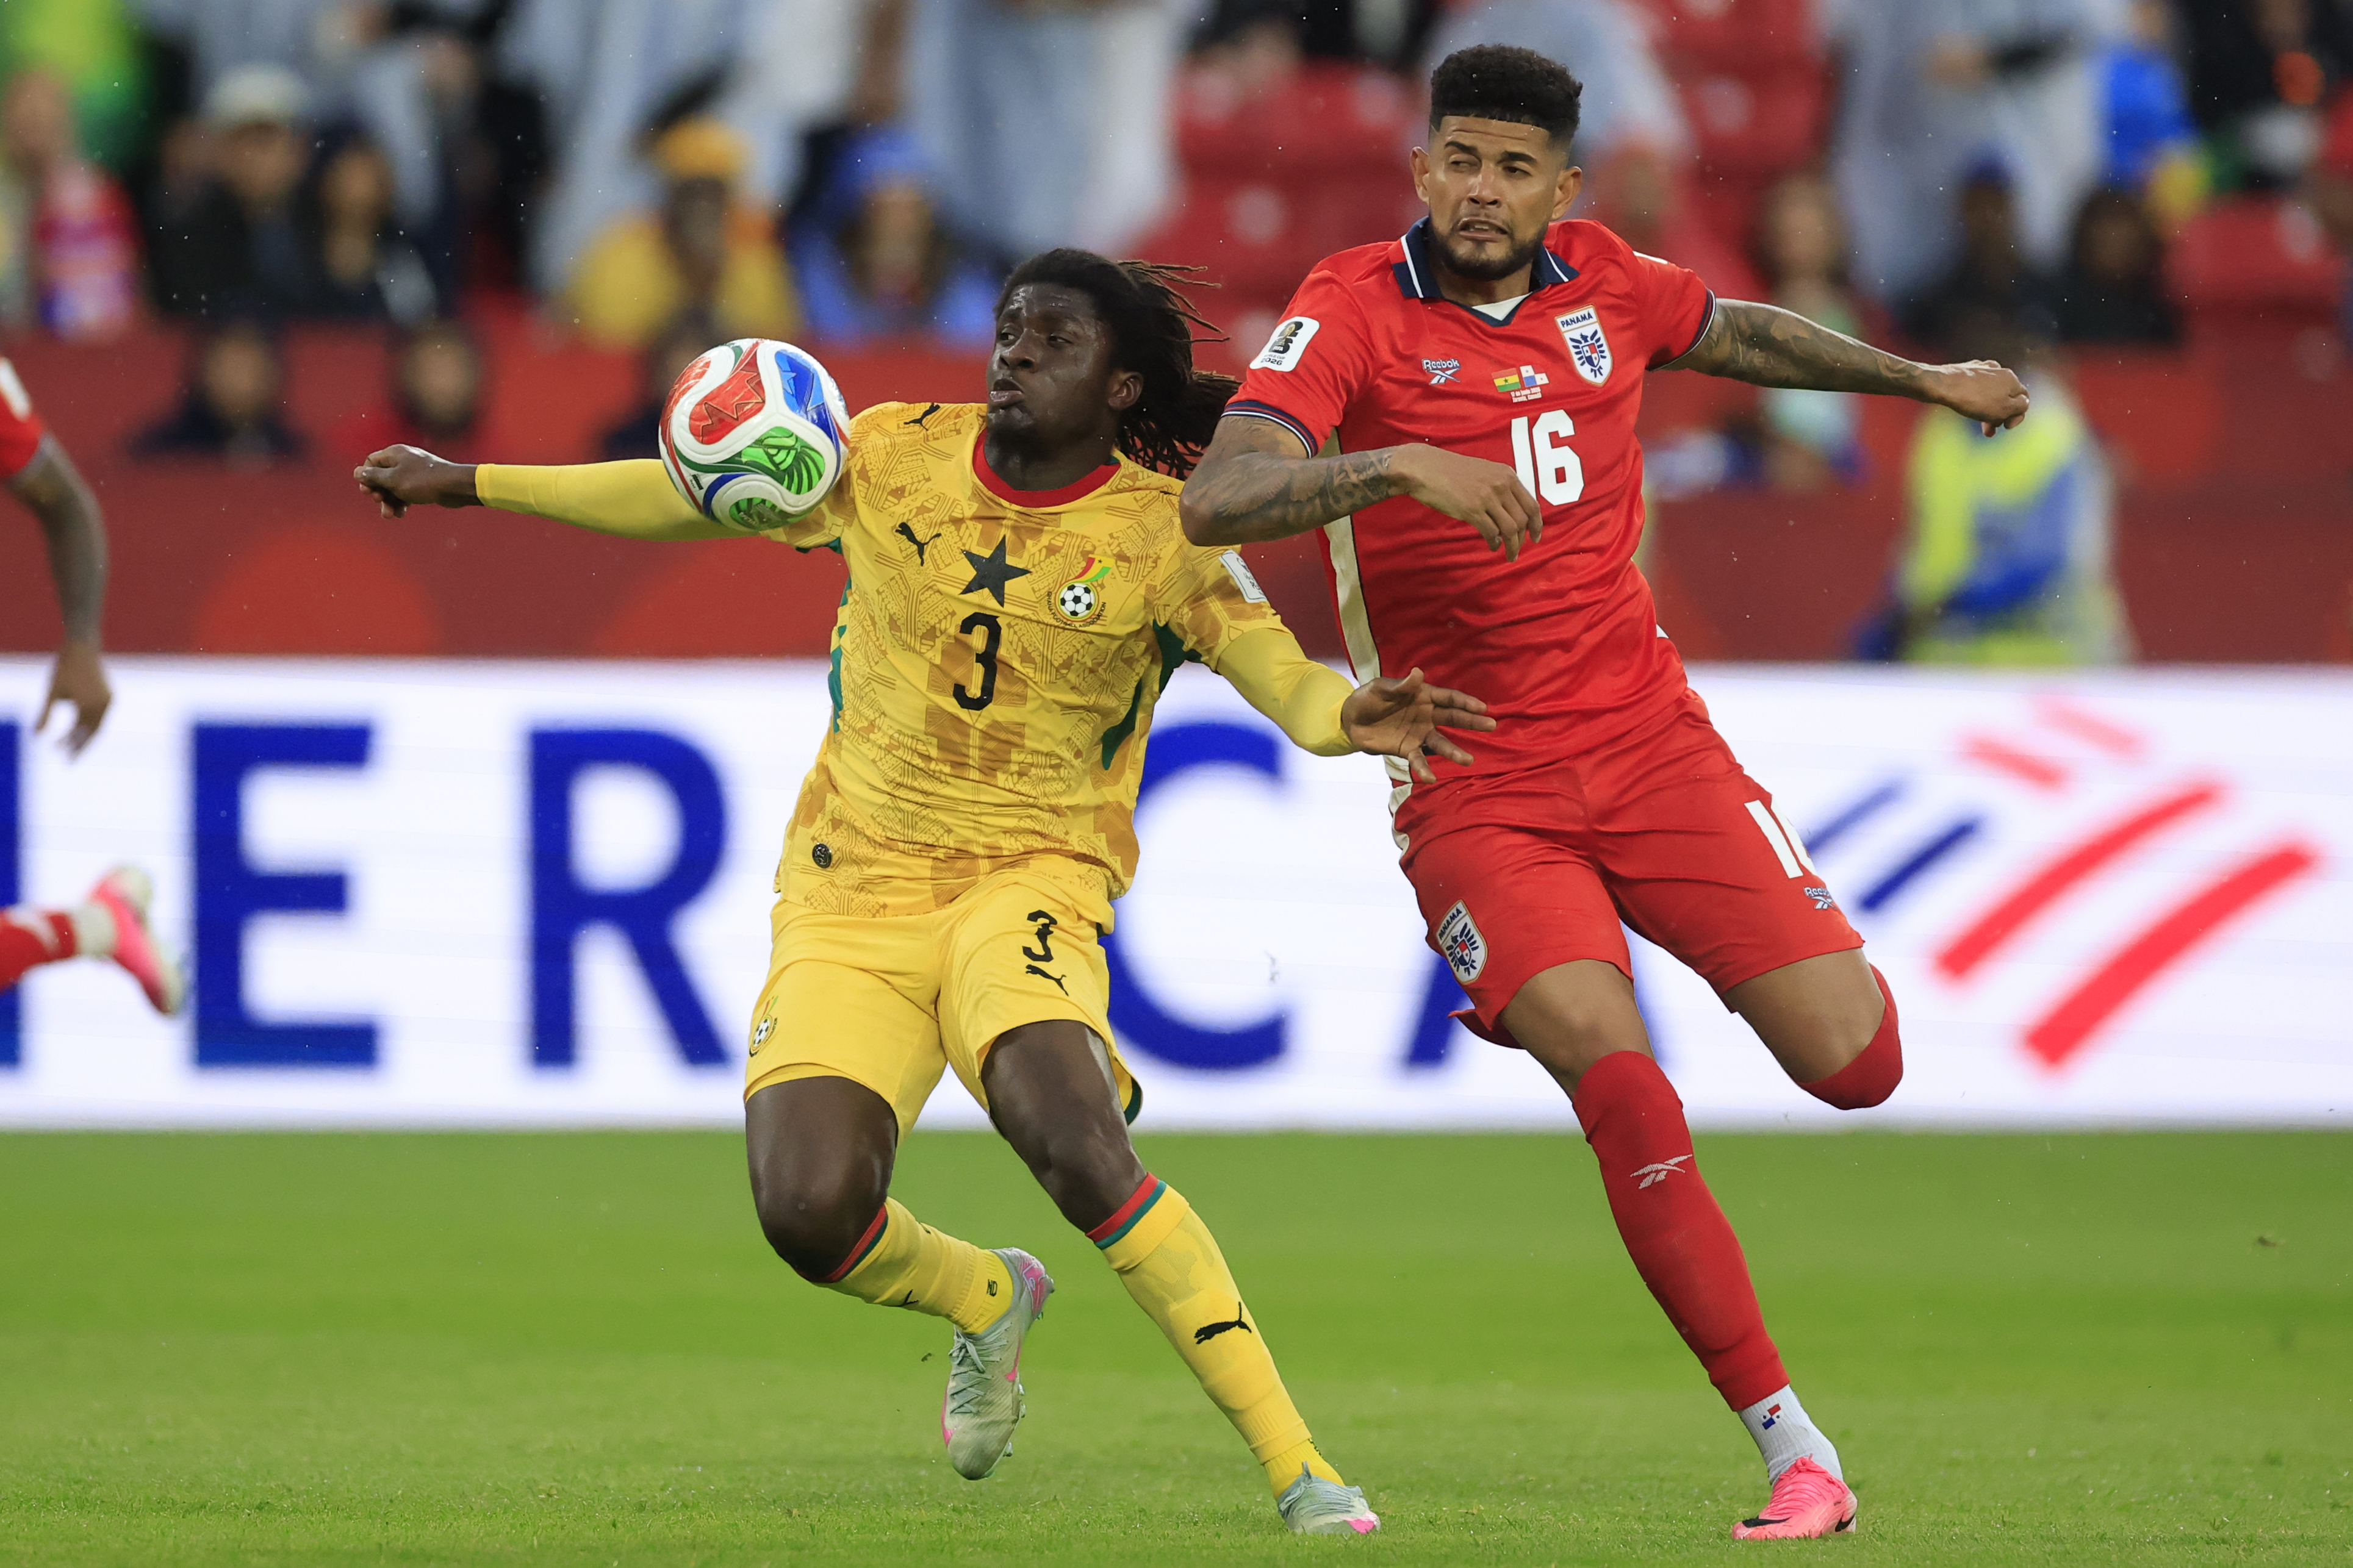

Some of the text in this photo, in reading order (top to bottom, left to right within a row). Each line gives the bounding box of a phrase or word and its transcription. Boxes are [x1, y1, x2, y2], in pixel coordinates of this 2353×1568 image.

[1560, 310, 1593, 328] PANAMÁ
[1423, 359, 1460, 370] Reebok
[1511, 409, 1585, 506] 16
[1051, 612, 1078, 628] FOOTBALL
[1078, 601, 1107, 628] ASSOCIATION
[953, 612, 1002, 711] 3
[1022, 909, 1057, 962] 3
